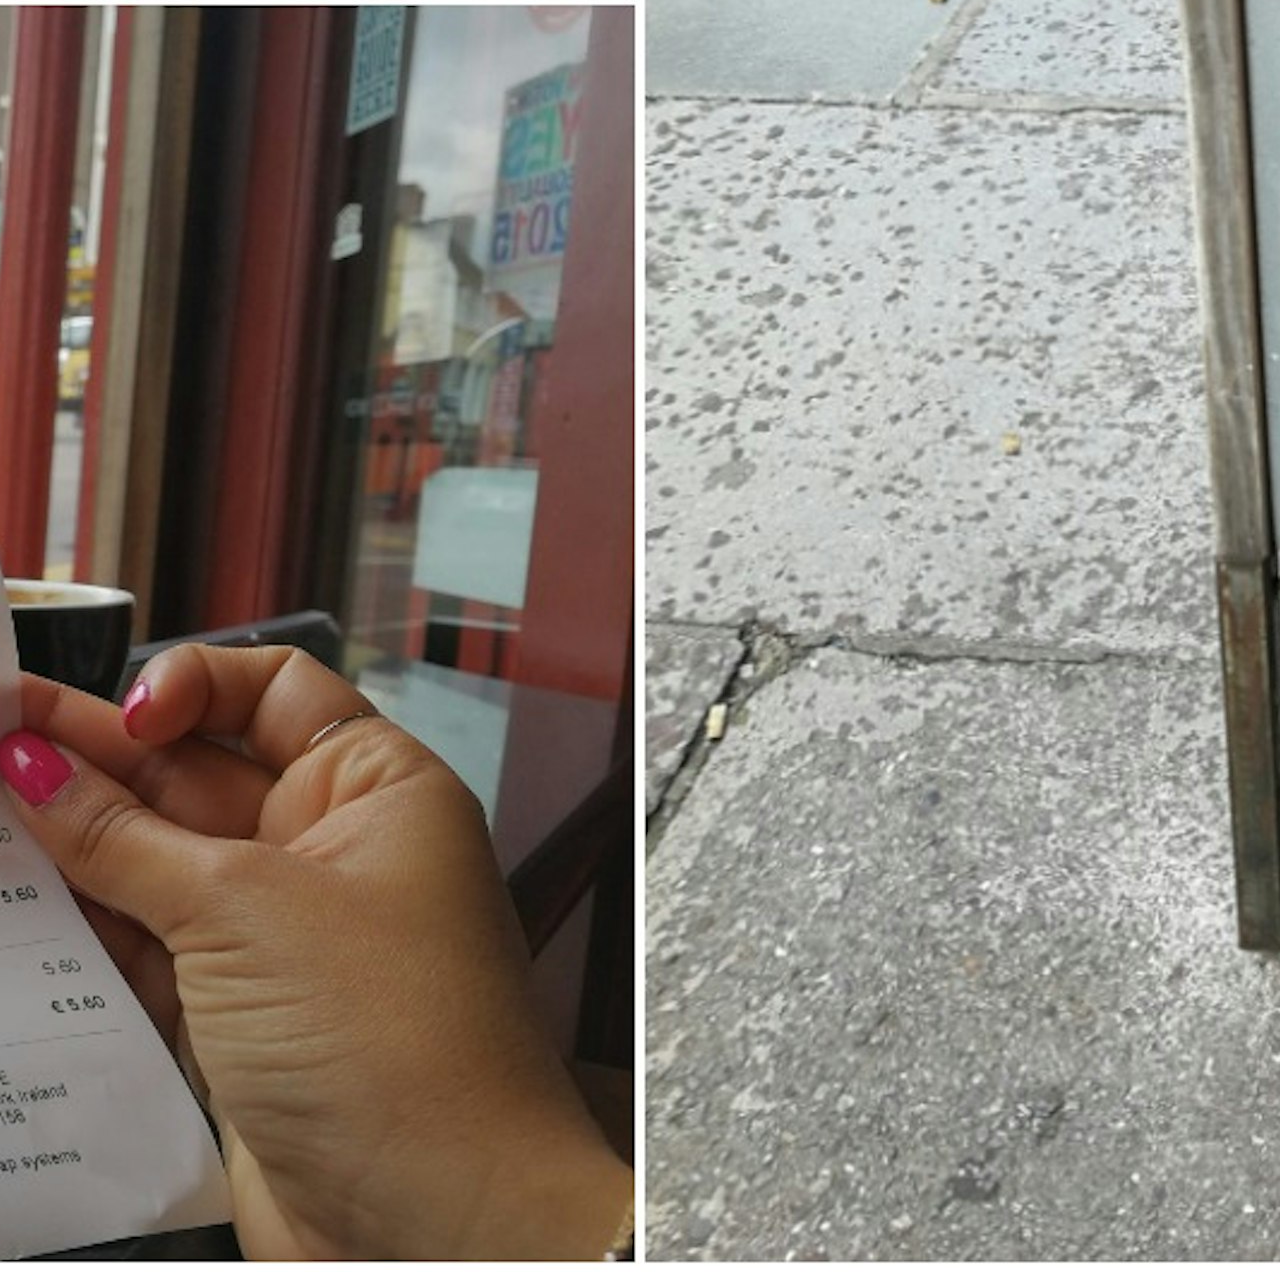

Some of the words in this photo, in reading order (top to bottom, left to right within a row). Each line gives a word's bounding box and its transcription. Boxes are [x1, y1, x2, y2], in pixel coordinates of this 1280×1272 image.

[1, 885, 39, 904] 5.60
[51, 999, 65, 1014] €
[66, 995, 106, 1012] 5.60
[18, 1083, 68, 1102] Ireland
[21, 1149, 82, 1172] systems
